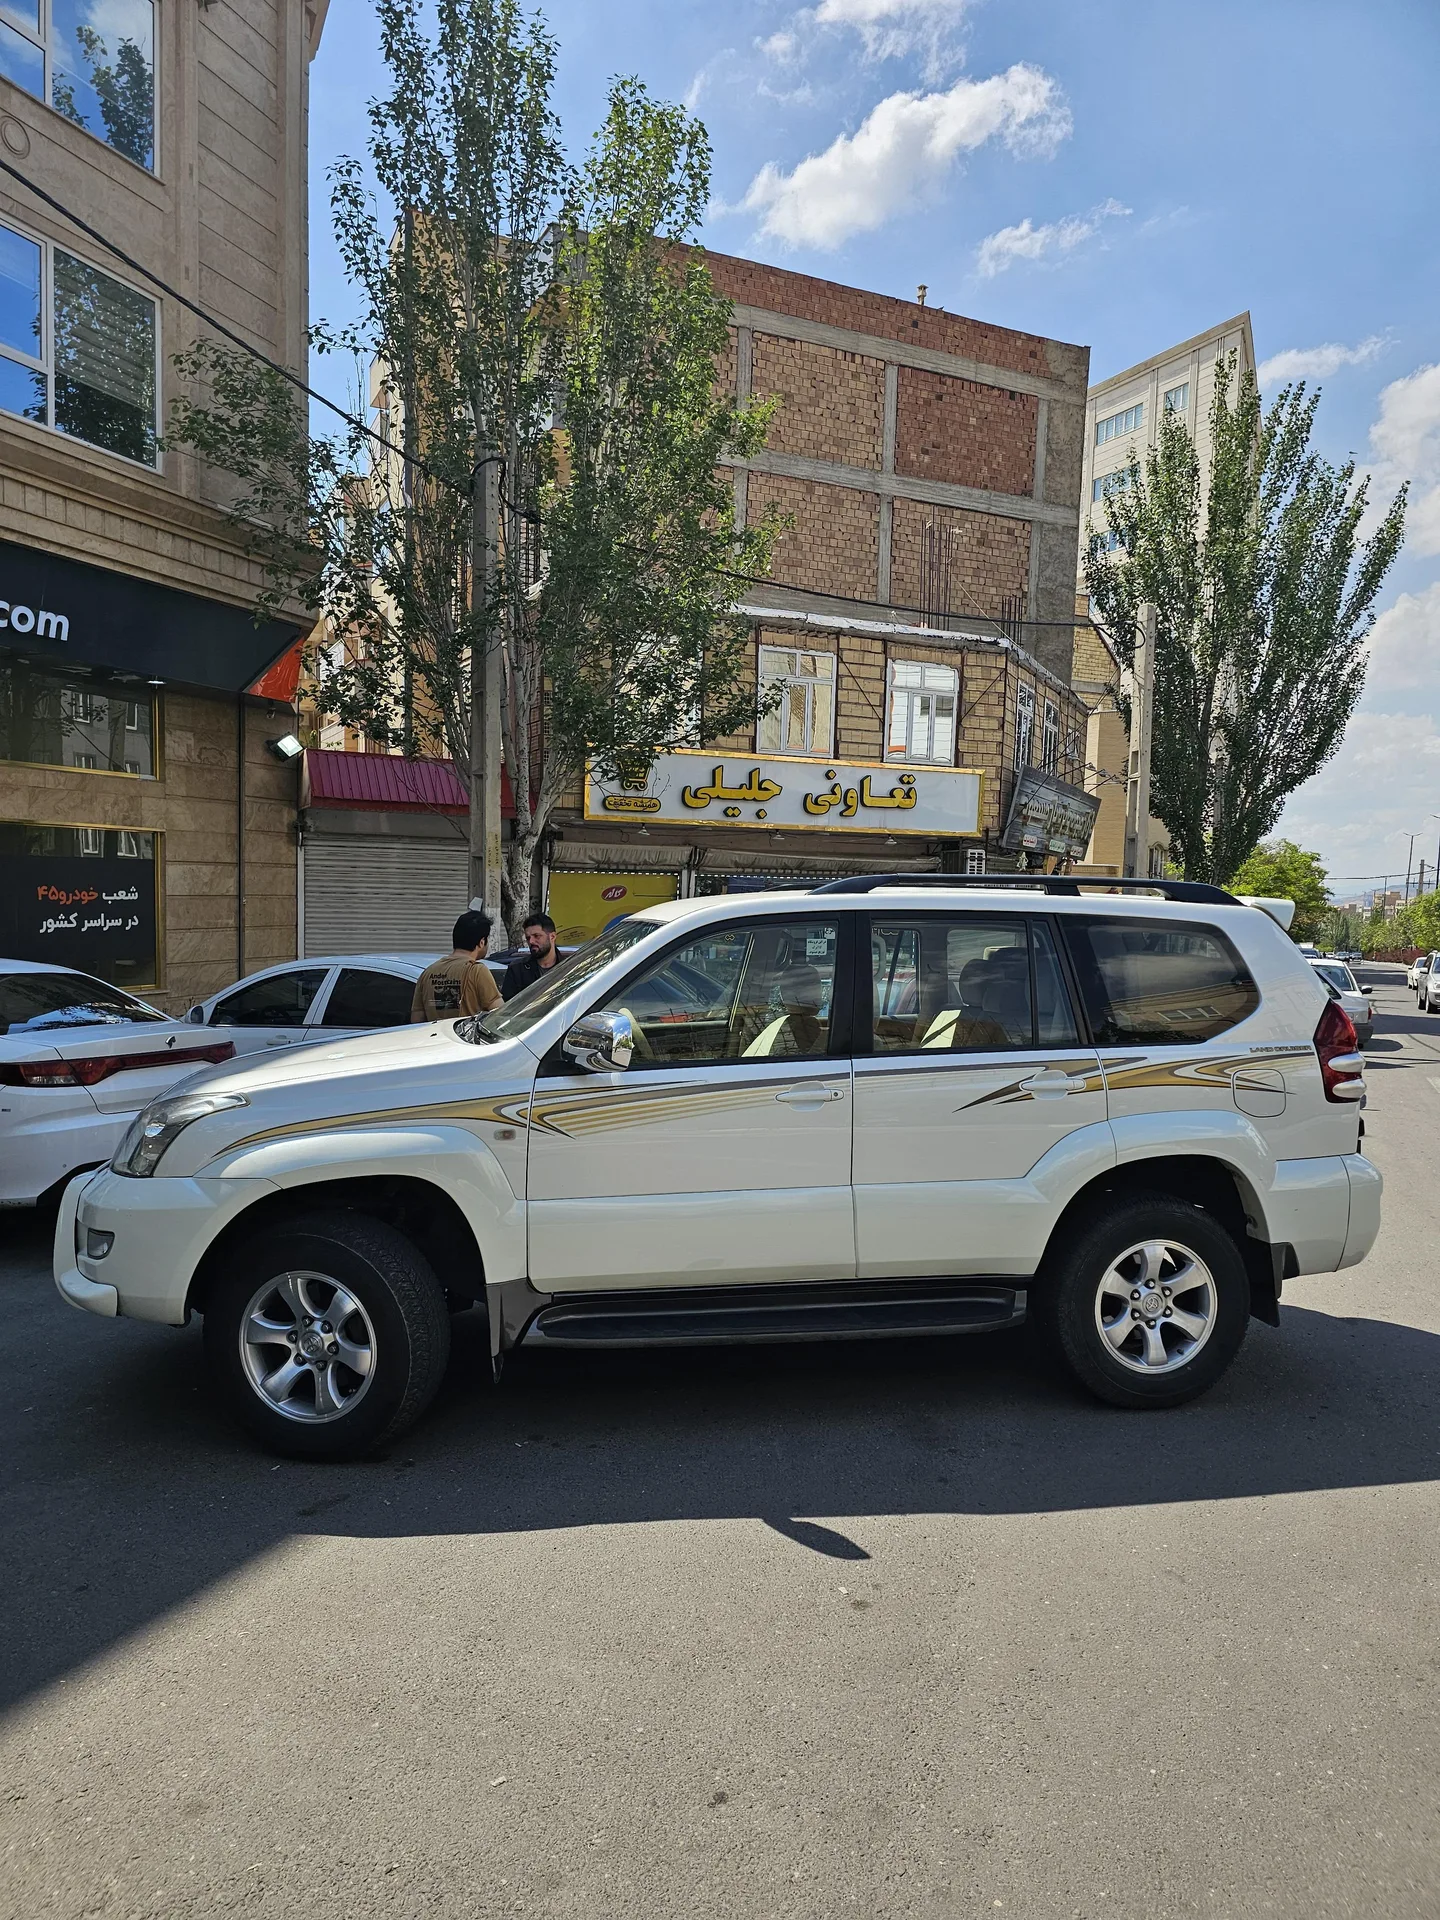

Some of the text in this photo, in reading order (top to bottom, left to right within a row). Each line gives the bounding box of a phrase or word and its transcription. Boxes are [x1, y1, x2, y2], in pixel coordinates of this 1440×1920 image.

[681, 764, 917, 820] تعاونی جلیلی
[102, 886, 139, 905] شعب
[39, 912, 139, 934] در سراسر کشور
